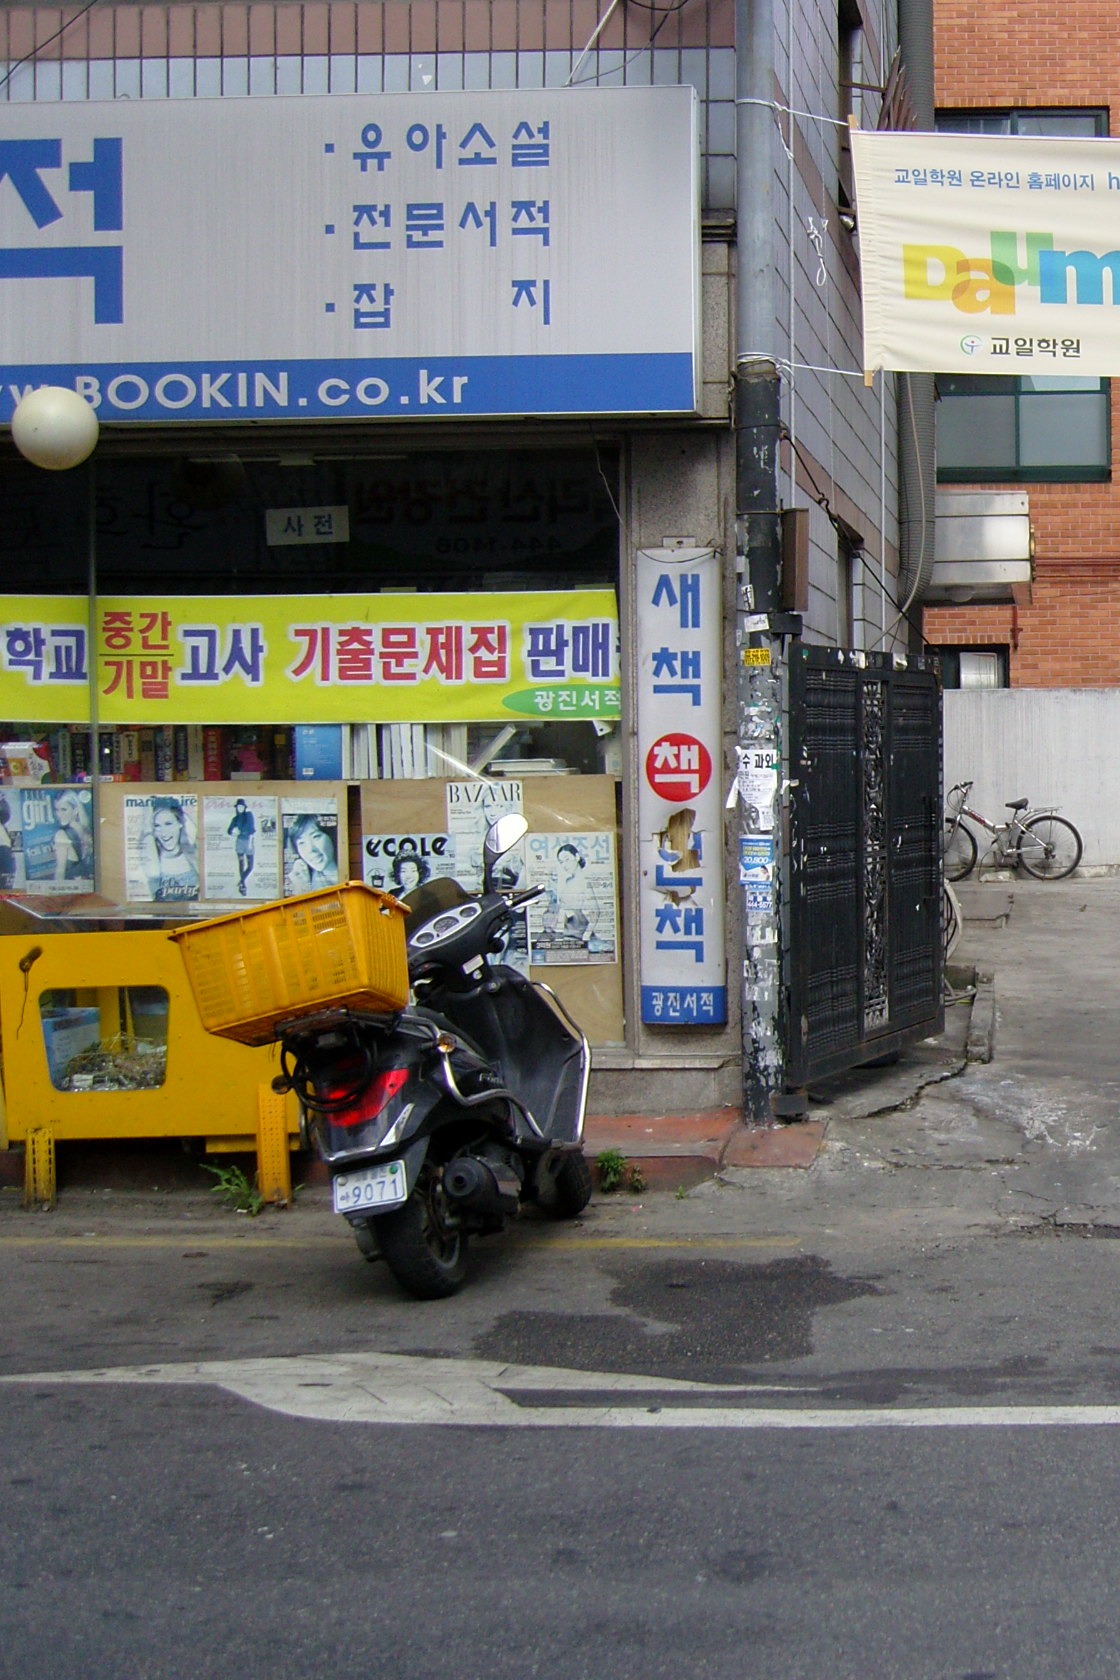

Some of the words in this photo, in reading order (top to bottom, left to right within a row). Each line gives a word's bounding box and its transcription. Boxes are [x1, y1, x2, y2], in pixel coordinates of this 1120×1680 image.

[352, 121, 551, 172] 유아소설
[894, 168, 963, 188] 교일학원
[969, 169, 1021, 190] 온라인
[1026, 172, 1096, 192] 홈페이지
[352, 199, 551, 251] 전문서적
[990, 336, 1082, 358] 교일학원
[102, 611, 172, 650] 중간
[180, 627, 264, 682] 고사
[290, 625, 507, 683] 기출문제집
[527, 622, 622, 679] 판매
[102, 659, 173, 699] 기말
[534, 690, 621, 711] 광진서적
[653, 741, 700, 794] 책
[754, 753, 774, 769] 과외
[449, 783, 521, 803] BAZAAR
[652, 991, 714, 1017] 광진서적
